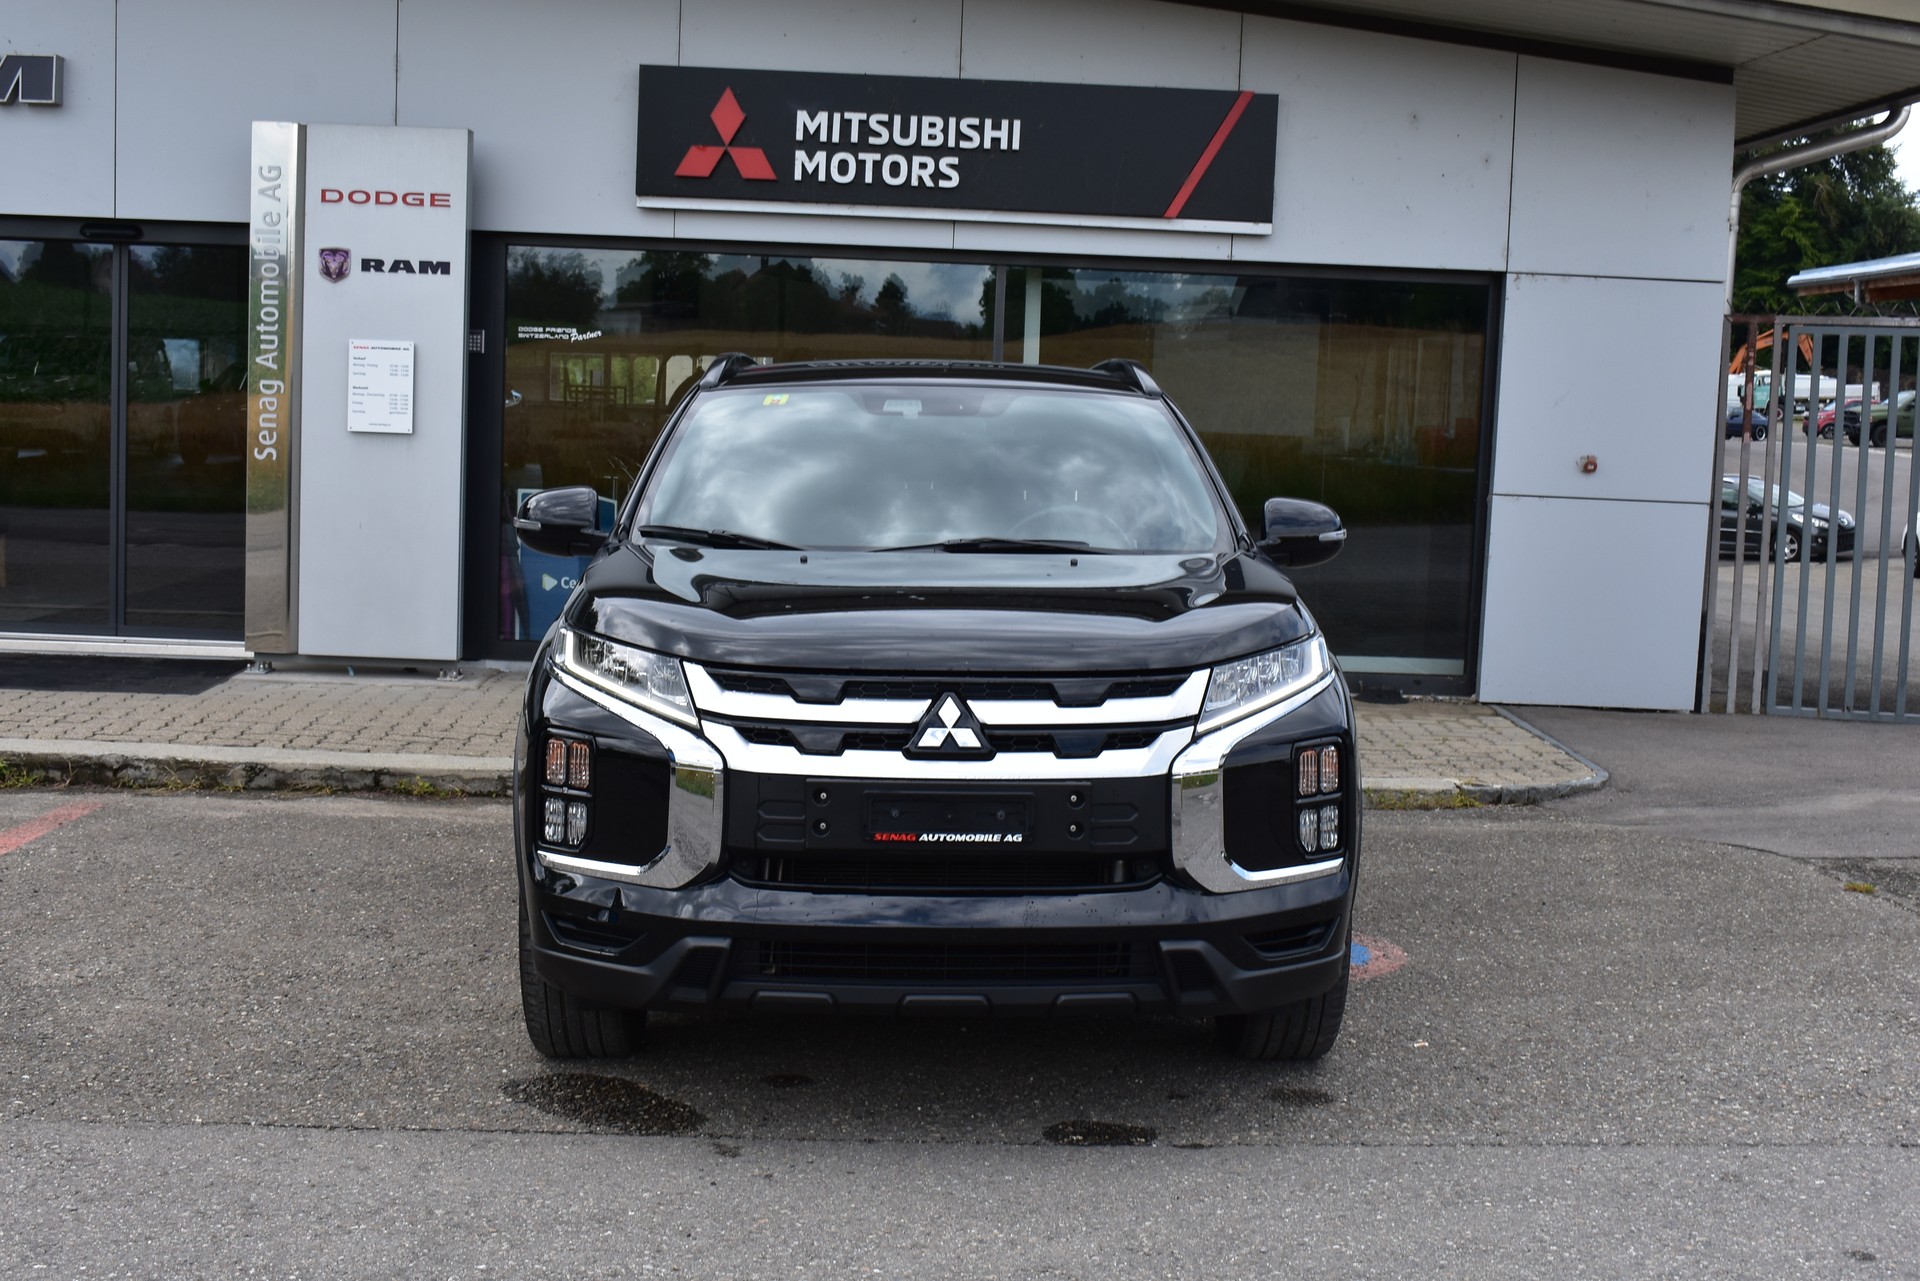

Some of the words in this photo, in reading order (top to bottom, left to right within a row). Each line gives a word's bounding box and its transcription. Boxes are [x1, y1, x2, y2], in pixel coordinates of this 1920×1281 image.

[795, 109, 1021, 151] MITSUBISHI
[257, 164, 282, 203] AG
[794, 149, 960, 189] MOTORS
[320, 188, 451, 208] DODGE
[360, 258, 451, 276] RAM
[254, 210, 281, 369] Automobile
[569, 330, 602, 344] Partner
[255, 379, 284, 461] Senag
[874, 832, 917, 842] SENAG
[918, 833, 1002, 842] AUTOMOBILE
[1003, 833, 1023, 843] AG
